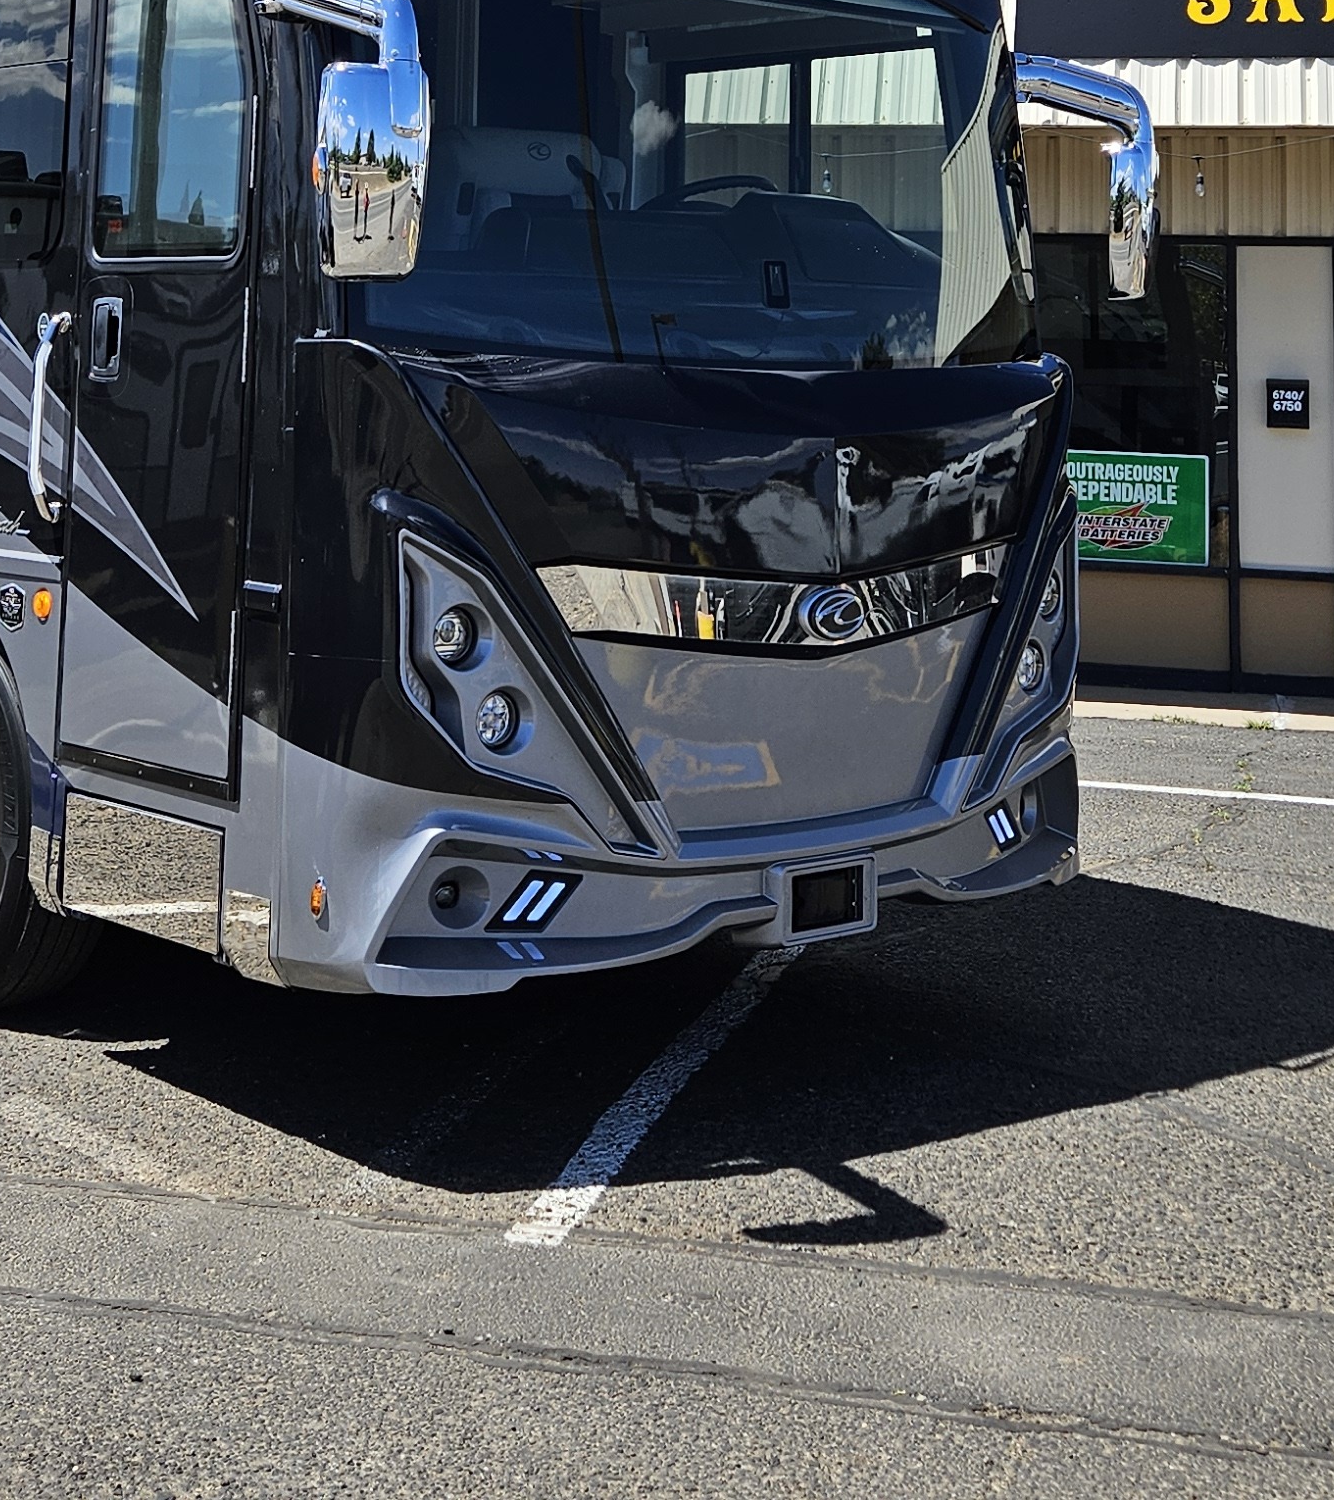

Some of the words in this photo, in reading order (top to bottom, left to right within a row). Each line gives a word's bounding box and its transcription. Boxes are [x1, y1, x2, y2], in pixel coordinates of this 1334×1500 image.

[1272, 389, 1305, 401] 6740/
[1272, 400, 1303, 412] 6750
[1066, 461, 1179, 484] OUTRAGEOUSLY
[1077, 514, 1168, 529] INTERSTATE
[1080, 527, 1161, 541] BATTERIES
